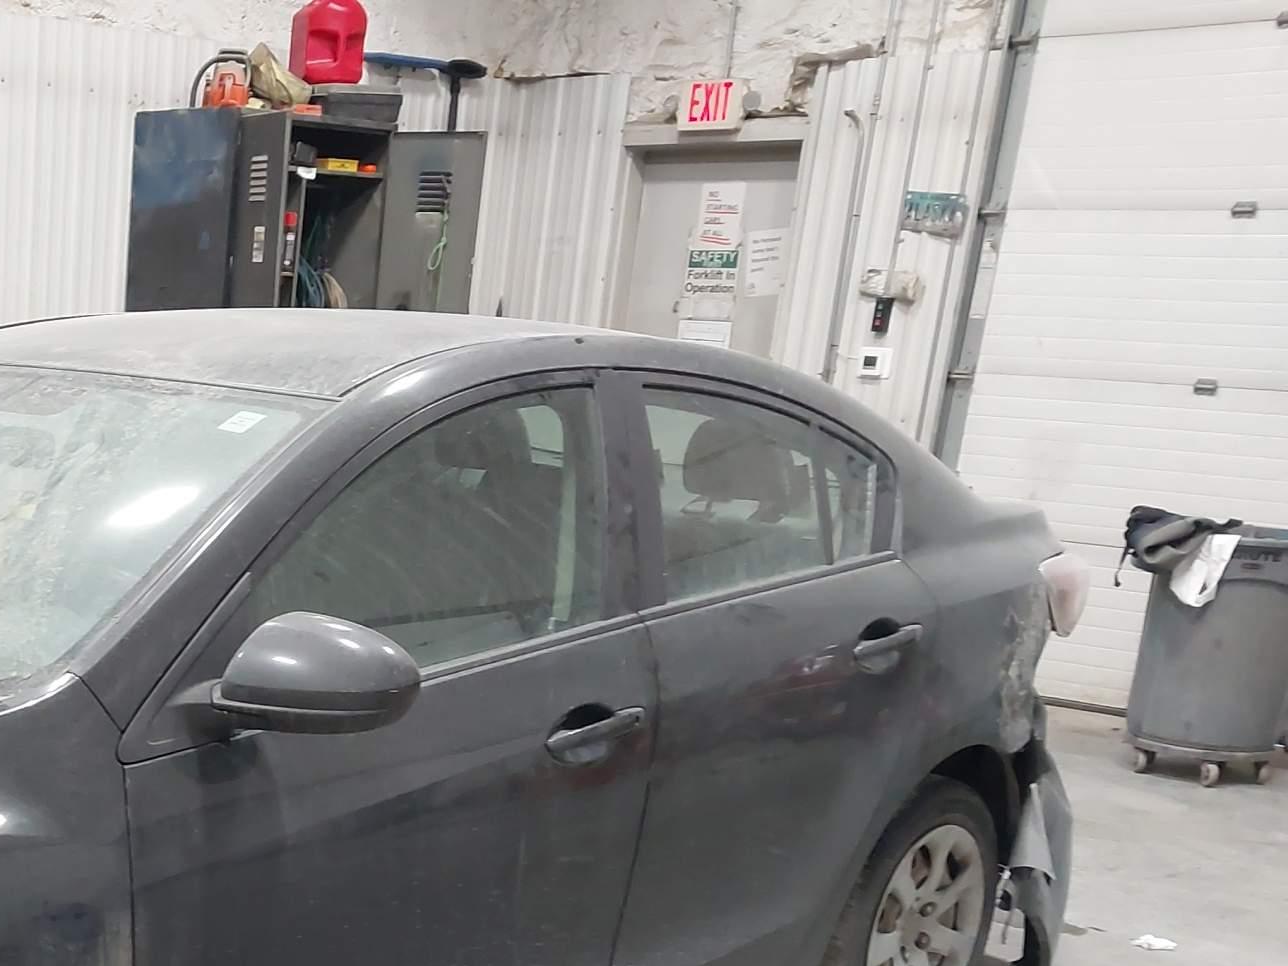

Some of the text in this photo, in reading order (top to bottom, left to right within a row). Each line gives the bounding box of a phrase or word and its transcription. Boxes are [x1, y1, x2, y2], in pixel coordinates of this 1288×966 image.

[688, 82, 733, 122] EXIT
[691, 251, 737, 262] SAFETY
[687, 269, 723, 280] Forklift
[684, 281, 735, 295] Operation
